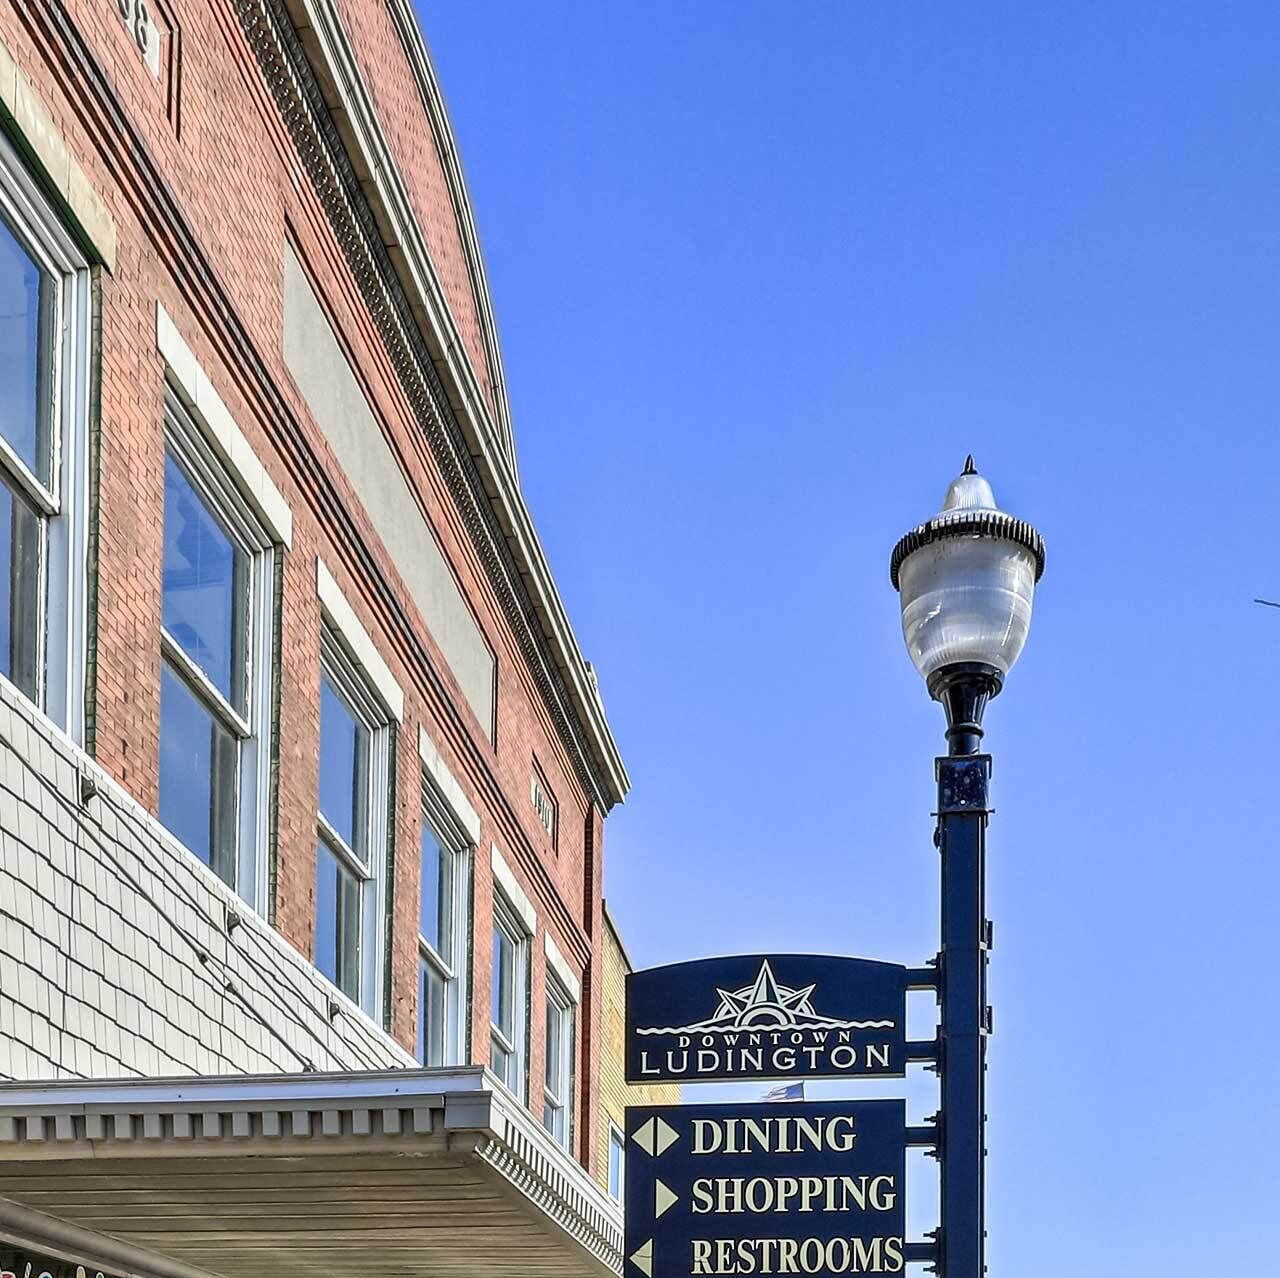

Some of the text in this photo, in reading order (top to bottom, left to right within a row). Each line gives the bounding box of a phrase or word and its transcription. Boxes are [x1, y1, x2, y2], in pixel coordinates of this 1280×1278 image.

[679, 1031, 851, 1048] DOWNTOWN
[640, 1044, 890, 1075] LUDINGTON
[691, 1117, 856, 1155] DINING
[692, 1175, 896, 1214] SHOPPING
[691, 1238, 904, 1276] RESTROOMS
